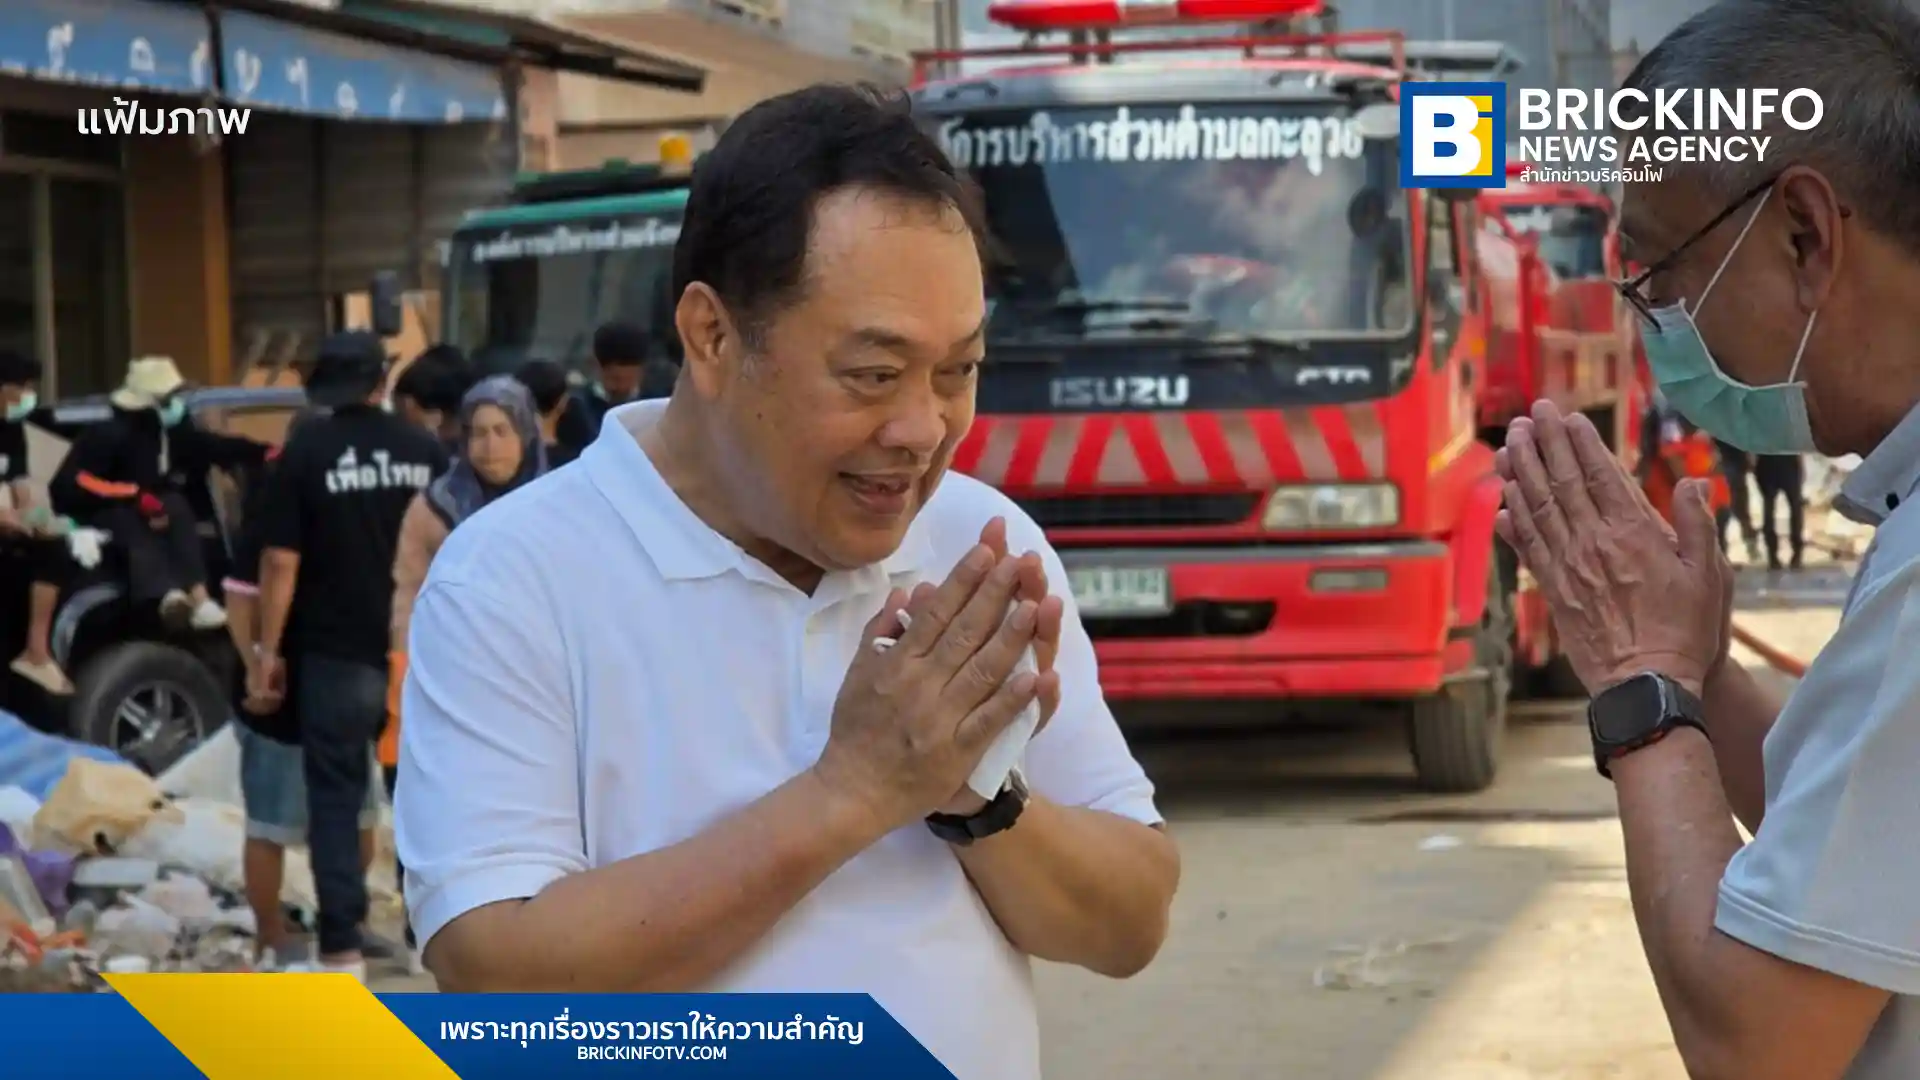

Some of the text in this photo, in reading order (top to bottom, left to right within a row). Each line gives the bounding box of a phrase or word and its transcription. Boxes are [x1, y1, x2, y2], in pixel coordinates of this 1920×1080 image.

[1050, 374, 1190, 407] ISUZU
[325, 445, 431, 494] เพื่อไทย
